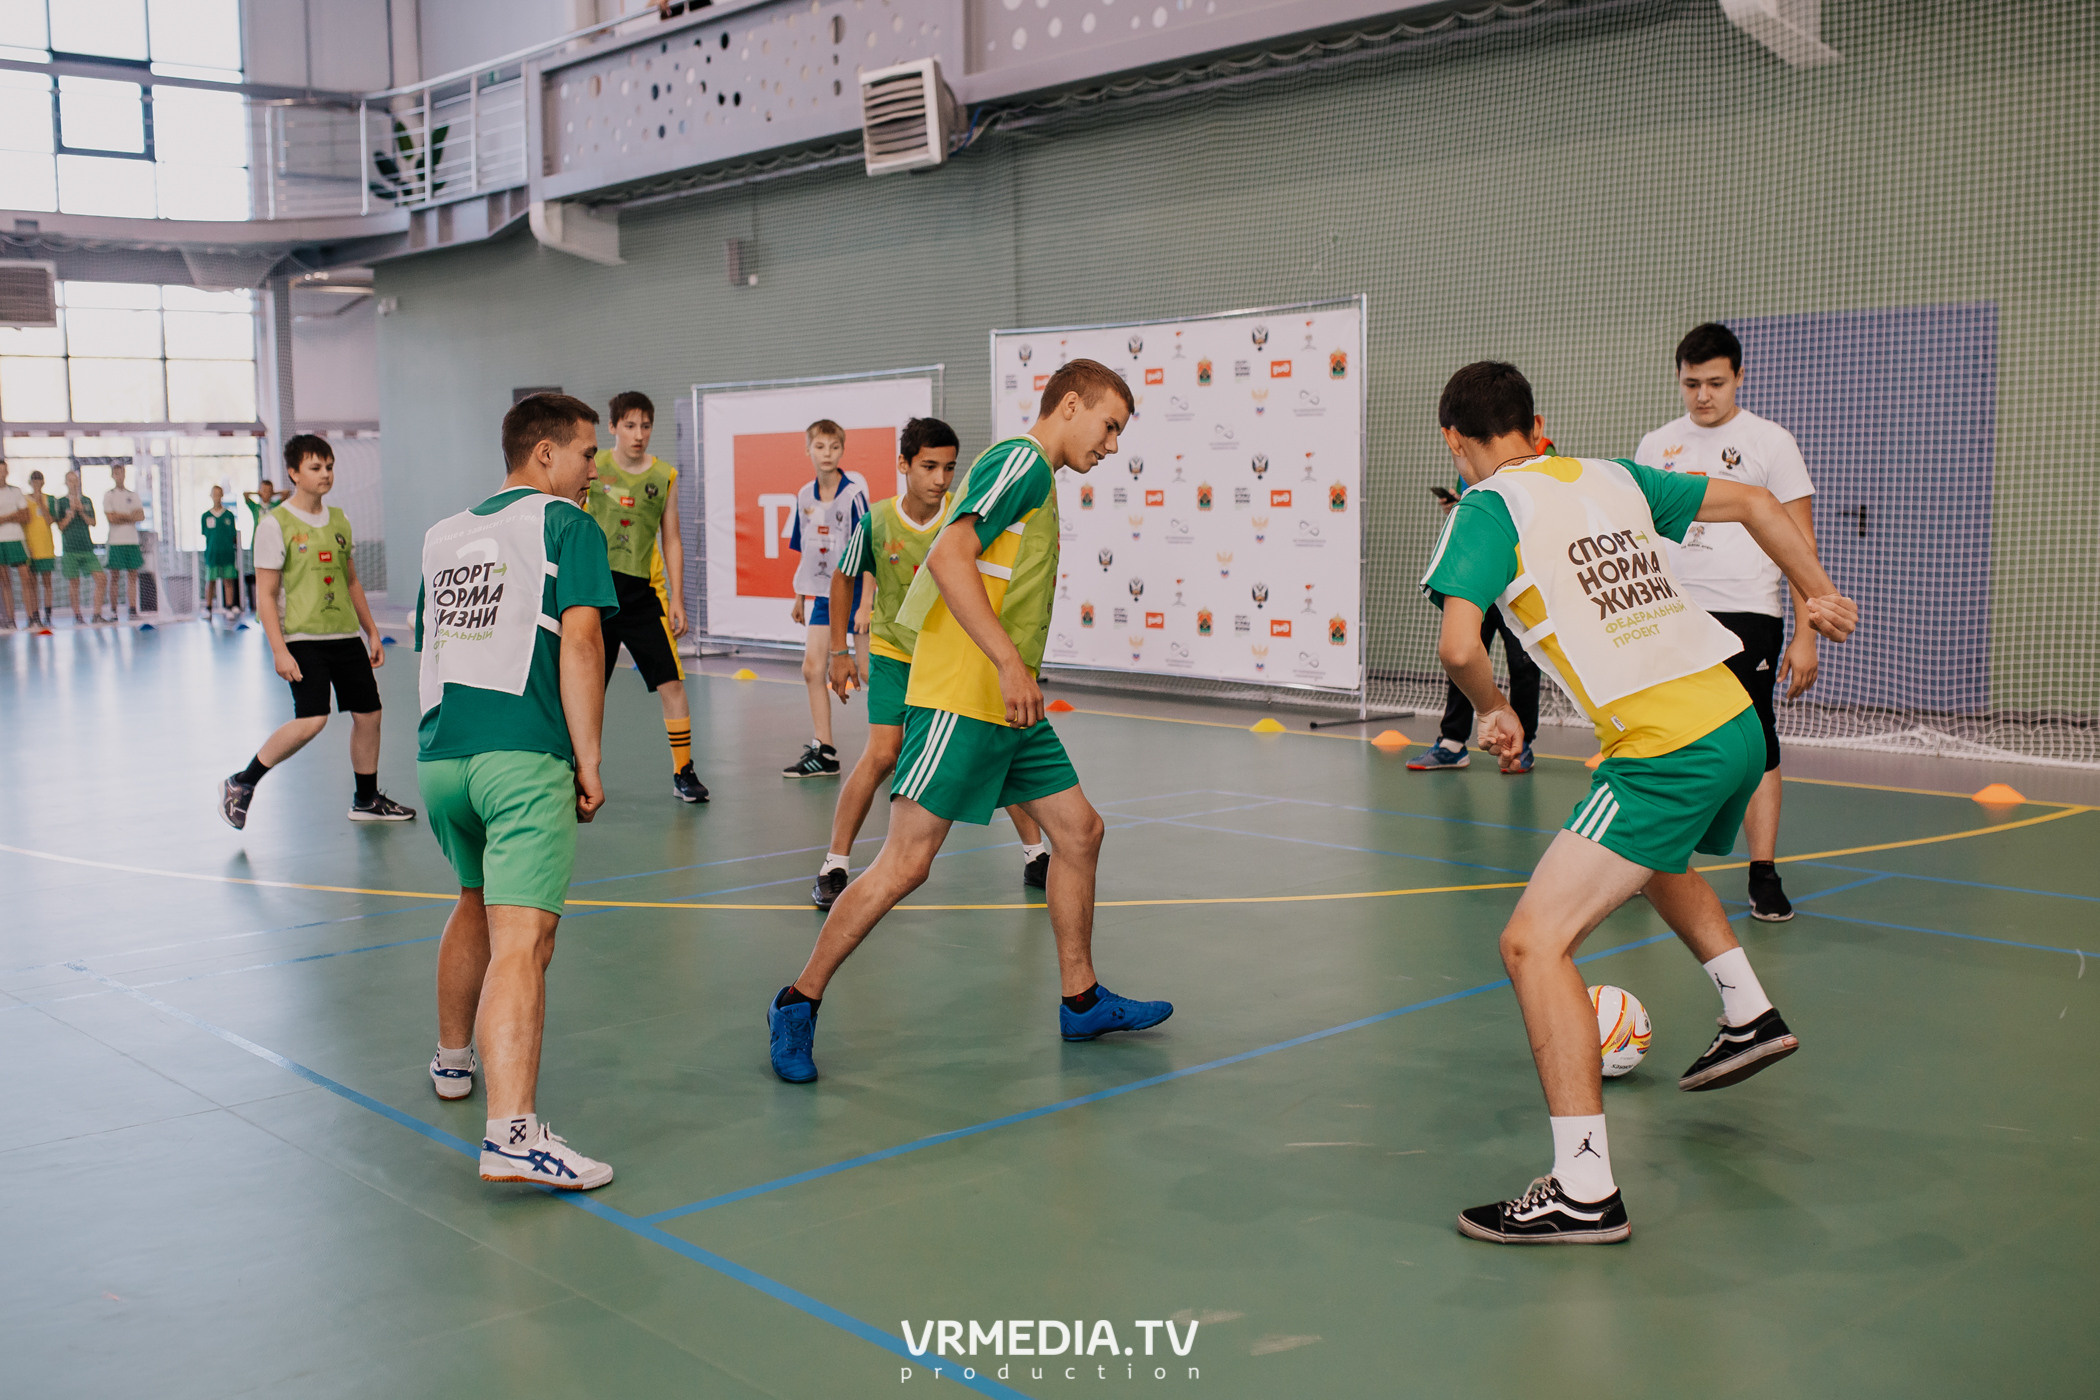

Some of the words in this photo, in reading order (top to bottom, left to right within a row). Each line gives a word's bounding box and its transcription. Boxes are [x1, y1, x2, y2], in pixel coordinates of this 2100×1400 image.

[1568, 530, 1639, 565] СПОРТ
[1577, 551, 1661, 595] НОРМА
[1590, 577, 1678, 620] ЖИЗНИ
[1605, 600, 1687, 633] ФЕДЕРАЛЬНЫЙ
[1613, 624, 1660, 648] ПРОЕКТ
